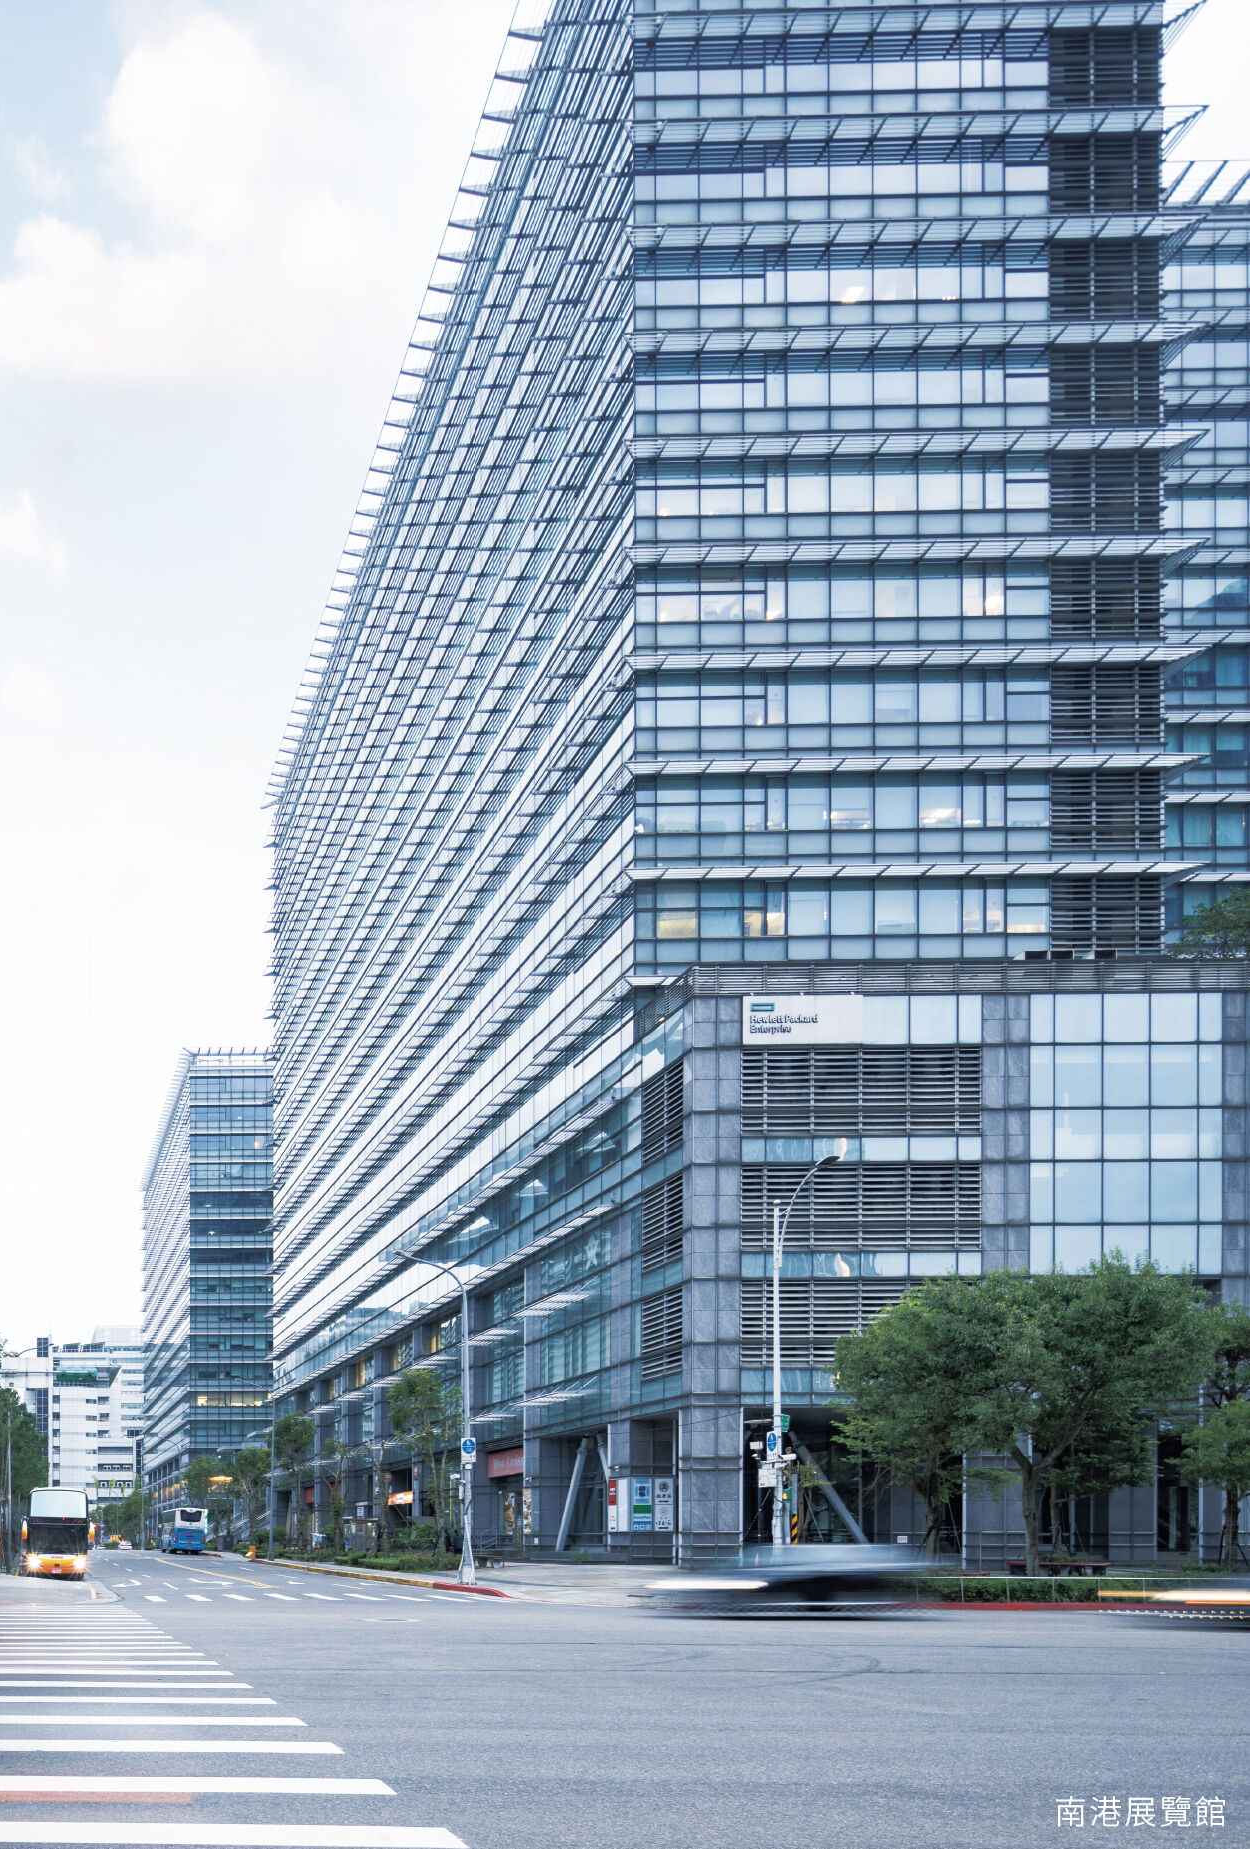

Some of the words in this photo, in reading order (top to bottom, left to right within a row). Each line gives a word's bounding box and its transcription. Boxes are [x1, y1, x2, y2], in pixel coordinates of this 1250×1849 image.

[750, 1014, 783, 1024] Hewlett
[784, 1013, 818, 1024] Packard
[750, 1025, 791, 1035] Enterprise
